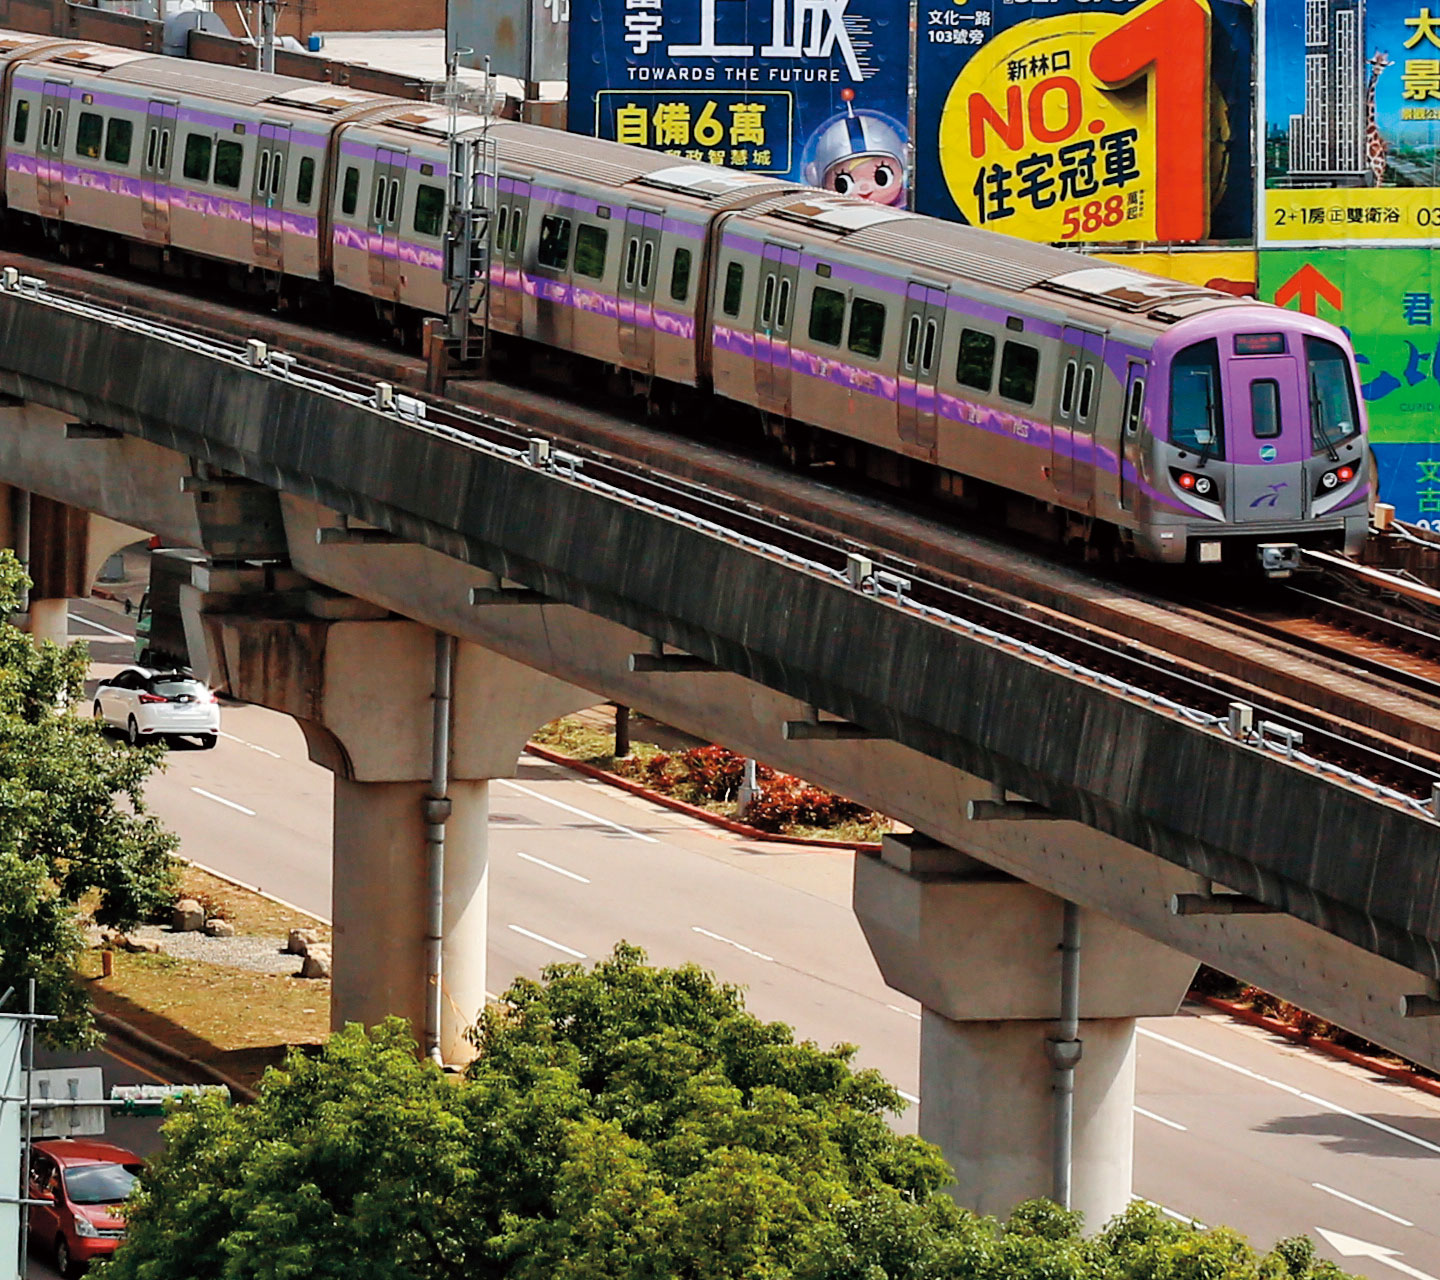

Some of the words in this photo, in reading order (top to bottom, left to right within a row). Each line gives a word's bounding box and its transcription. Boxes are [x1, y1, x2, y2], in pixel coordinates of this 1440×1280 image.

[927, 9, 992, 26] 文化一路
[927, 28, 985, 45] 103號旁
[627, 66, 716, 83] TOWARDS
[724, 66, 760, 83] THE
[768, 67, 841, 83] FUTURE
[1006, 49, 1072, 82] 新林口
[616, 100, 767, 147] 自備6萬
[972, 127, 1141, 225] 住宅冠軍
[1060, 194, 1125, 240] 588
[1399, 402, 1435, 413] CUPID
